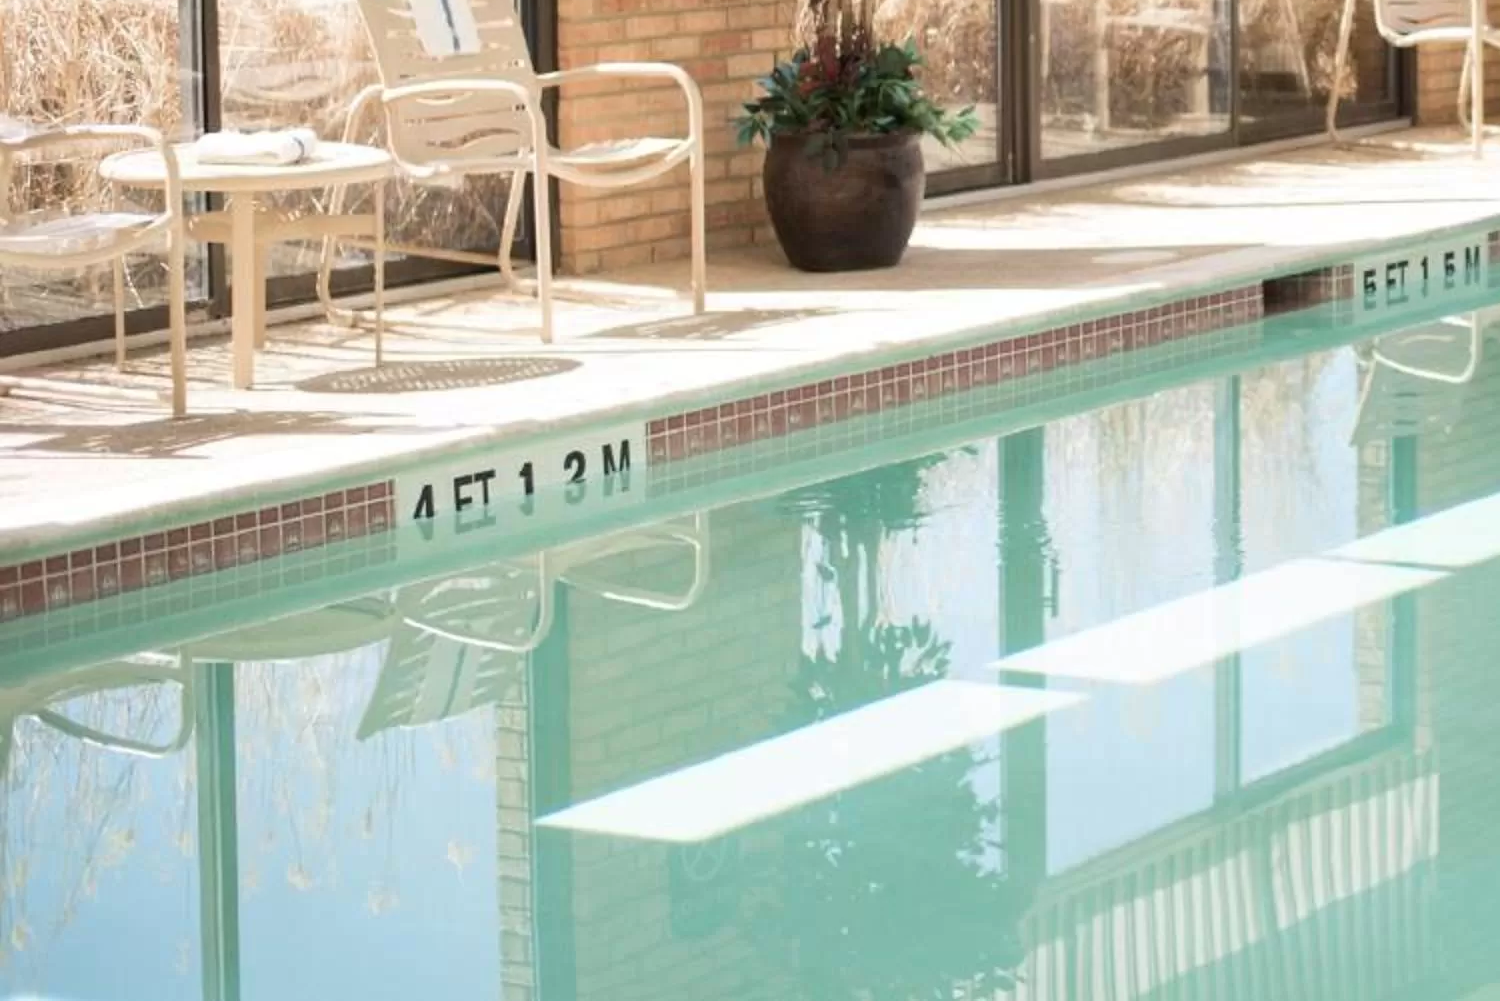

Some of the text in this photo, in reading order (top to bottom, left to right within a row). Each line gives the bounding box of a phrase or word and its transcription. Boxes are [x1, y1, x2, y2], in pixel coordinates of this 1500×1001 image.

[453, 468, 497, 512] FT
[519, 460, 535, 496] 1
[563, 450, 587, 485] 2
[602, 438, 631, 476] M
